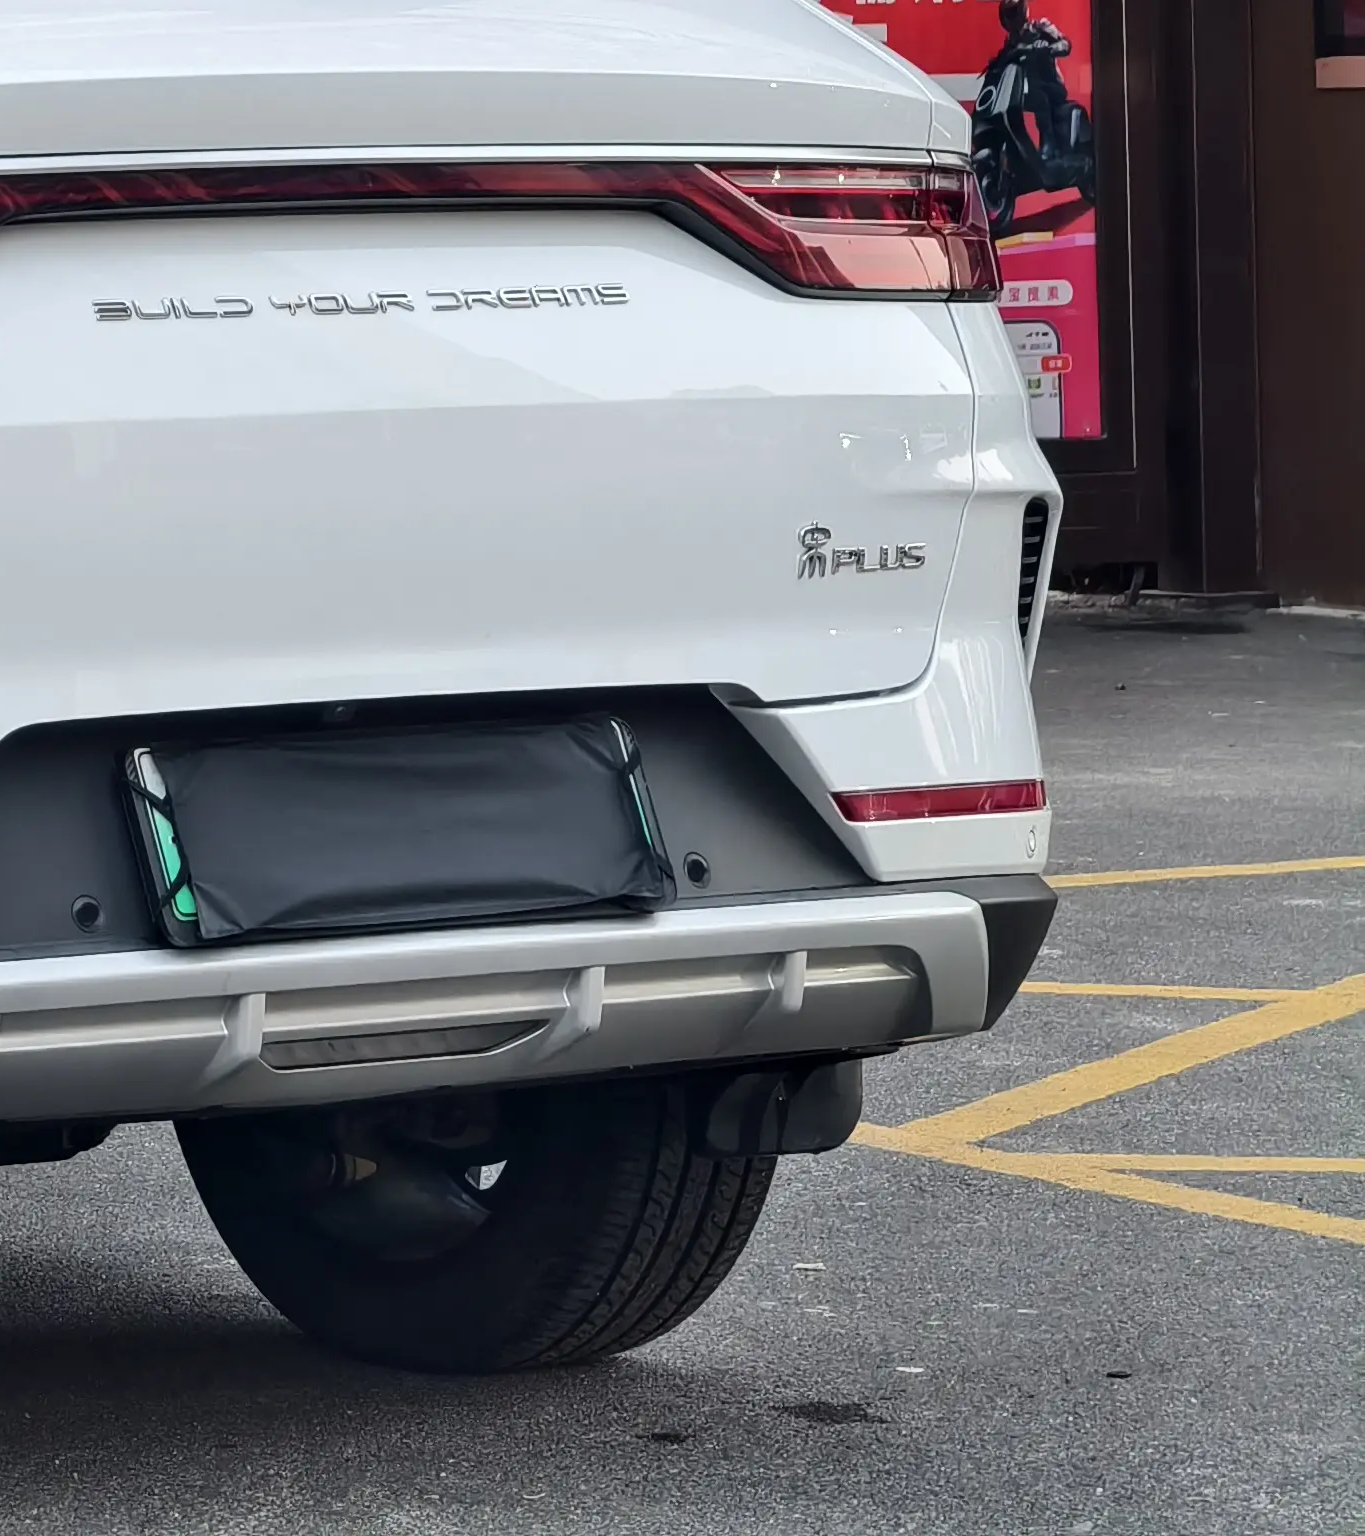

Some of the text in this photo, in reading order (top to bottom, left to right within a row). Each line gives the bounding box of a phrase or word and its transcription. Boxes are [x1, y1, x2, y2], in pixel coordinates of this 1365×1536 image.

[91, 282, 631, 322] BUILD YOUR DREAMS
